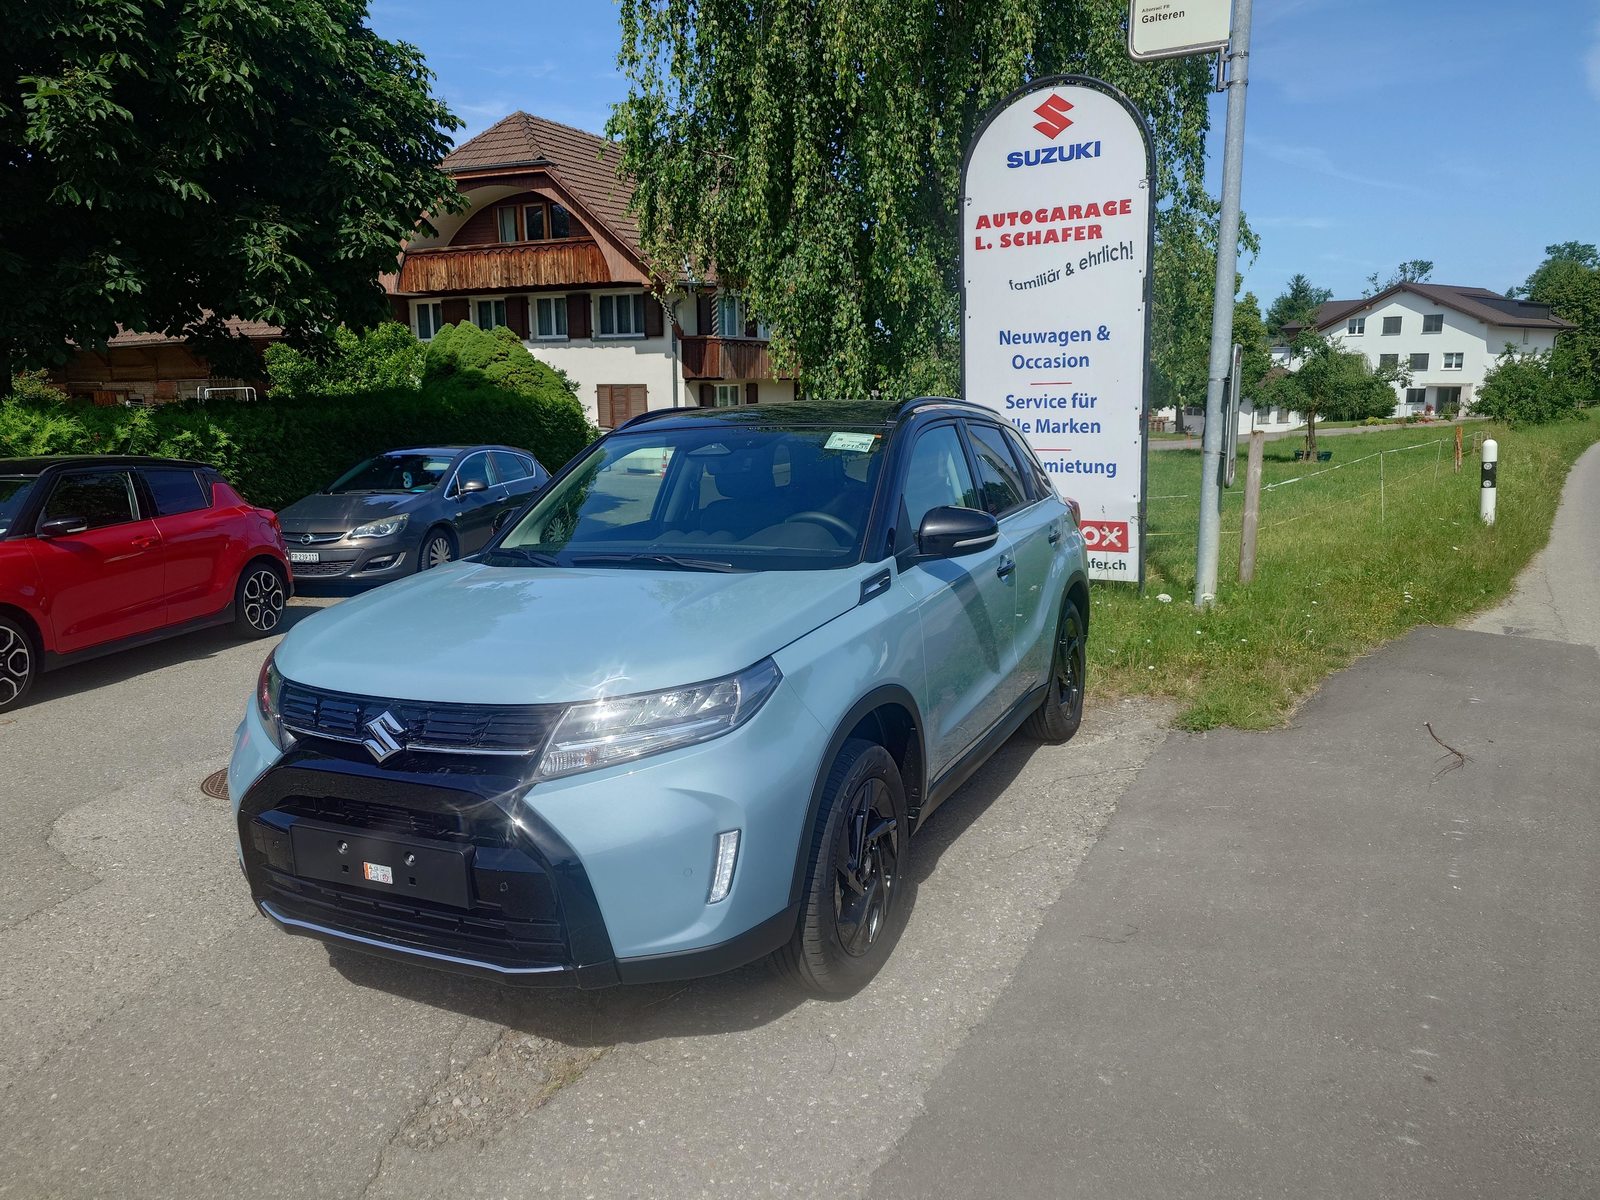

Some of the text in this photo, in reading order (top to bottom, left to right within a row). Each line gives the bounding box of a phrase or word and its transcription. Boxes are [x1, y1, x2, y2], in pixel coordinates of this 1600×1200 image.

[1141, 10, 1185, 24] Galteren
[1006, 140, 1101, 169] SUZUKI
[975, 198, 1132, 230] AUTOGARAGE
[975, 224, 1103, 251] L. SCHAFER
[1008, 240, 1134, 291] familiär & ehrlich!
[999, 324, 1111, 347] Neuwagen &
[1011, 352, 1090, 370] Occasion
[1005, 392, 1098, 410] Service für
[1035, 417, 1101, 434] Marken
[1043, 458, 1117, 478] mietung
